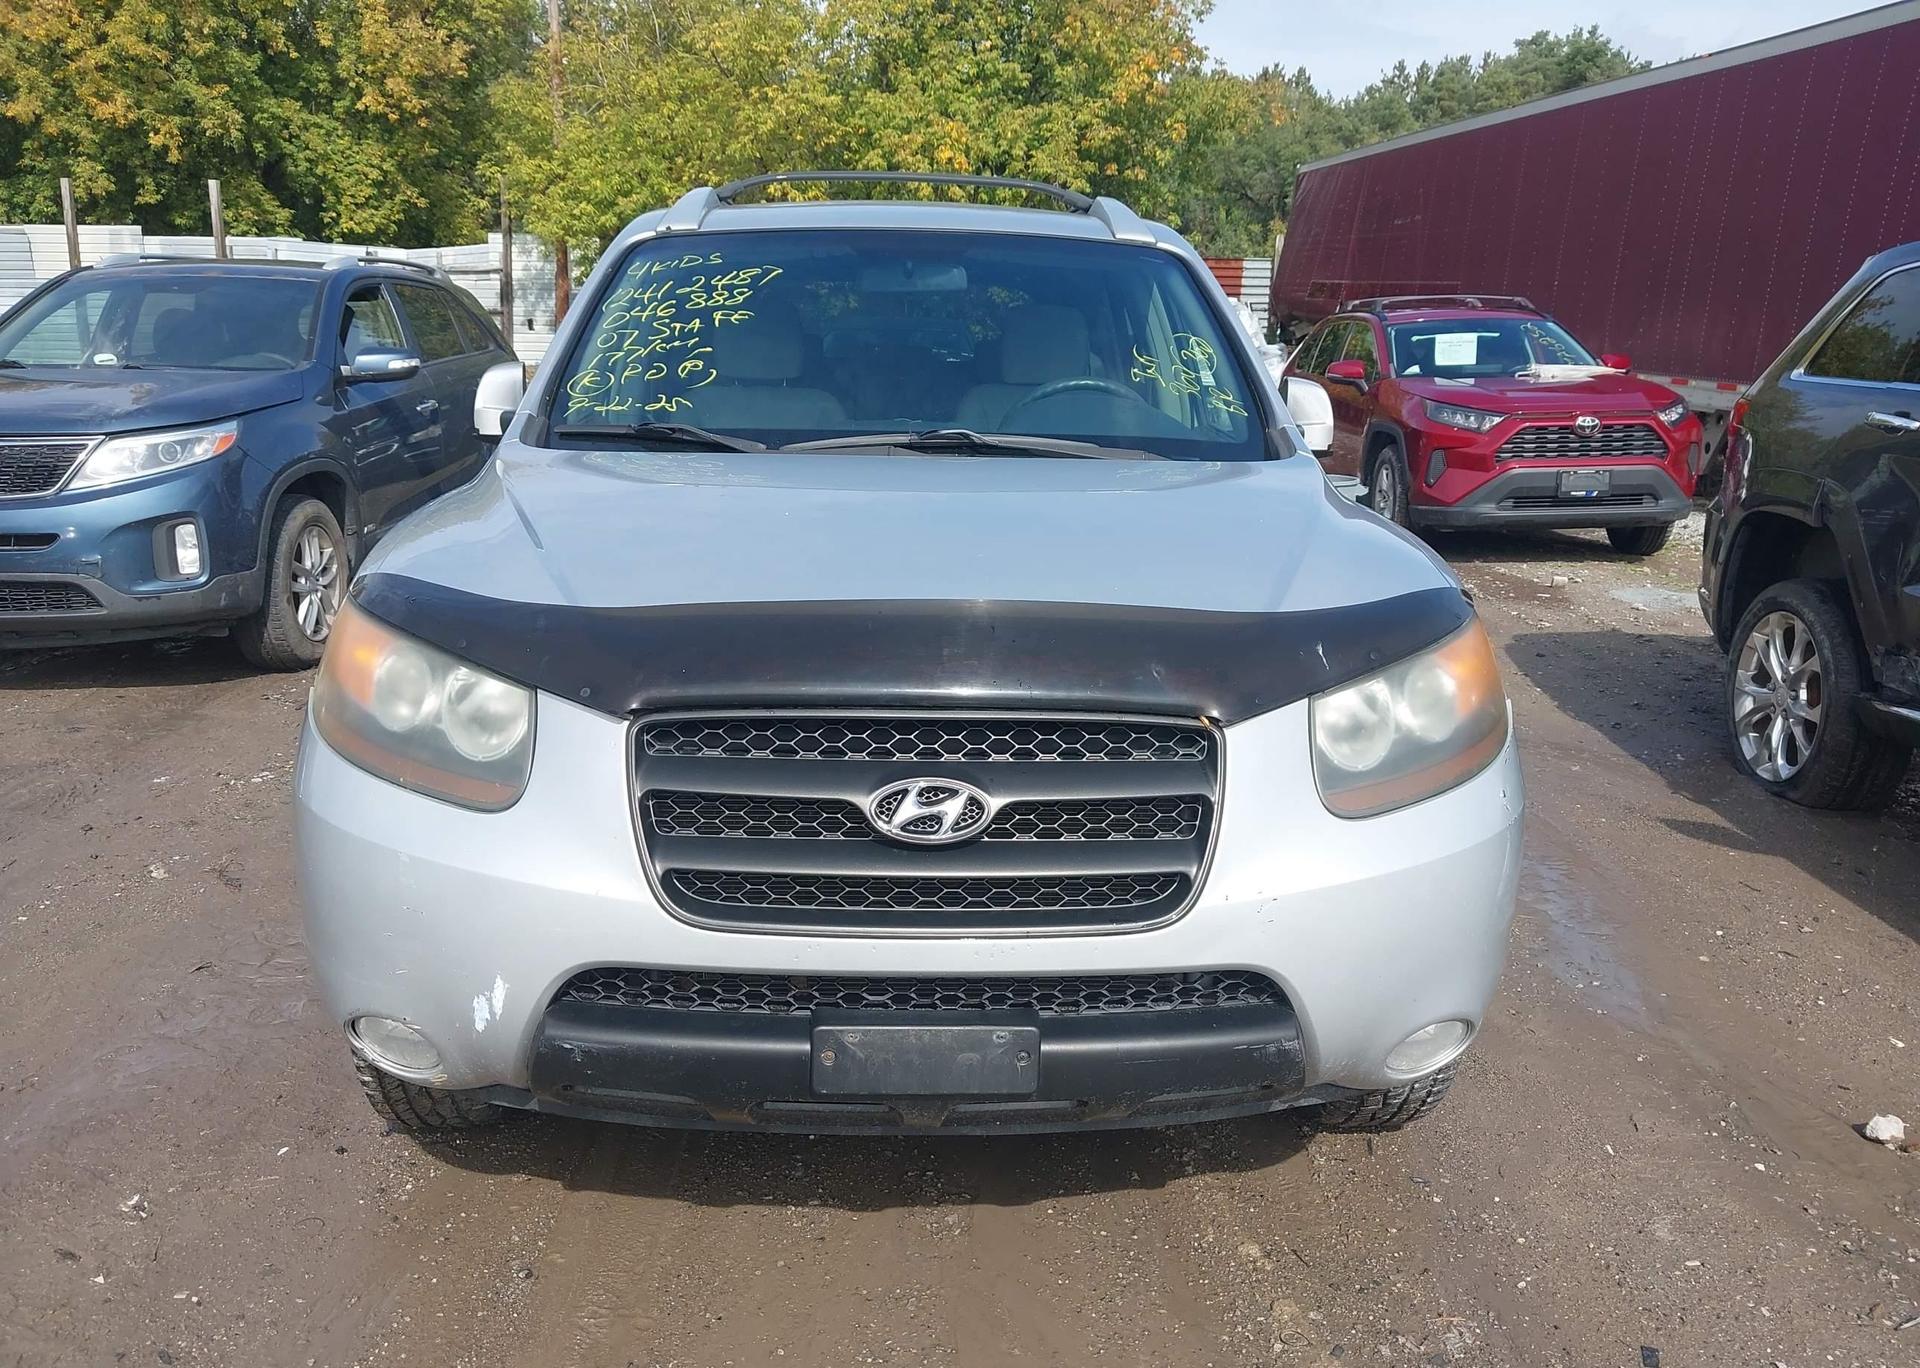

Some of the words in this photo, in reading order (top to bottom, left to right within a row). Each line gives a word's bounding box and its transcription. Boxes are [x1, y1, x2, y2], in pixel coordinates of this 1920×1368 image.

[676, 266, 784, 291] 2487
[686, 288, 753, 308] 888
[597, 331, 638, 349] 07
[649, 318, 704, 340] STA
[713, 310, 755, 328] FE
